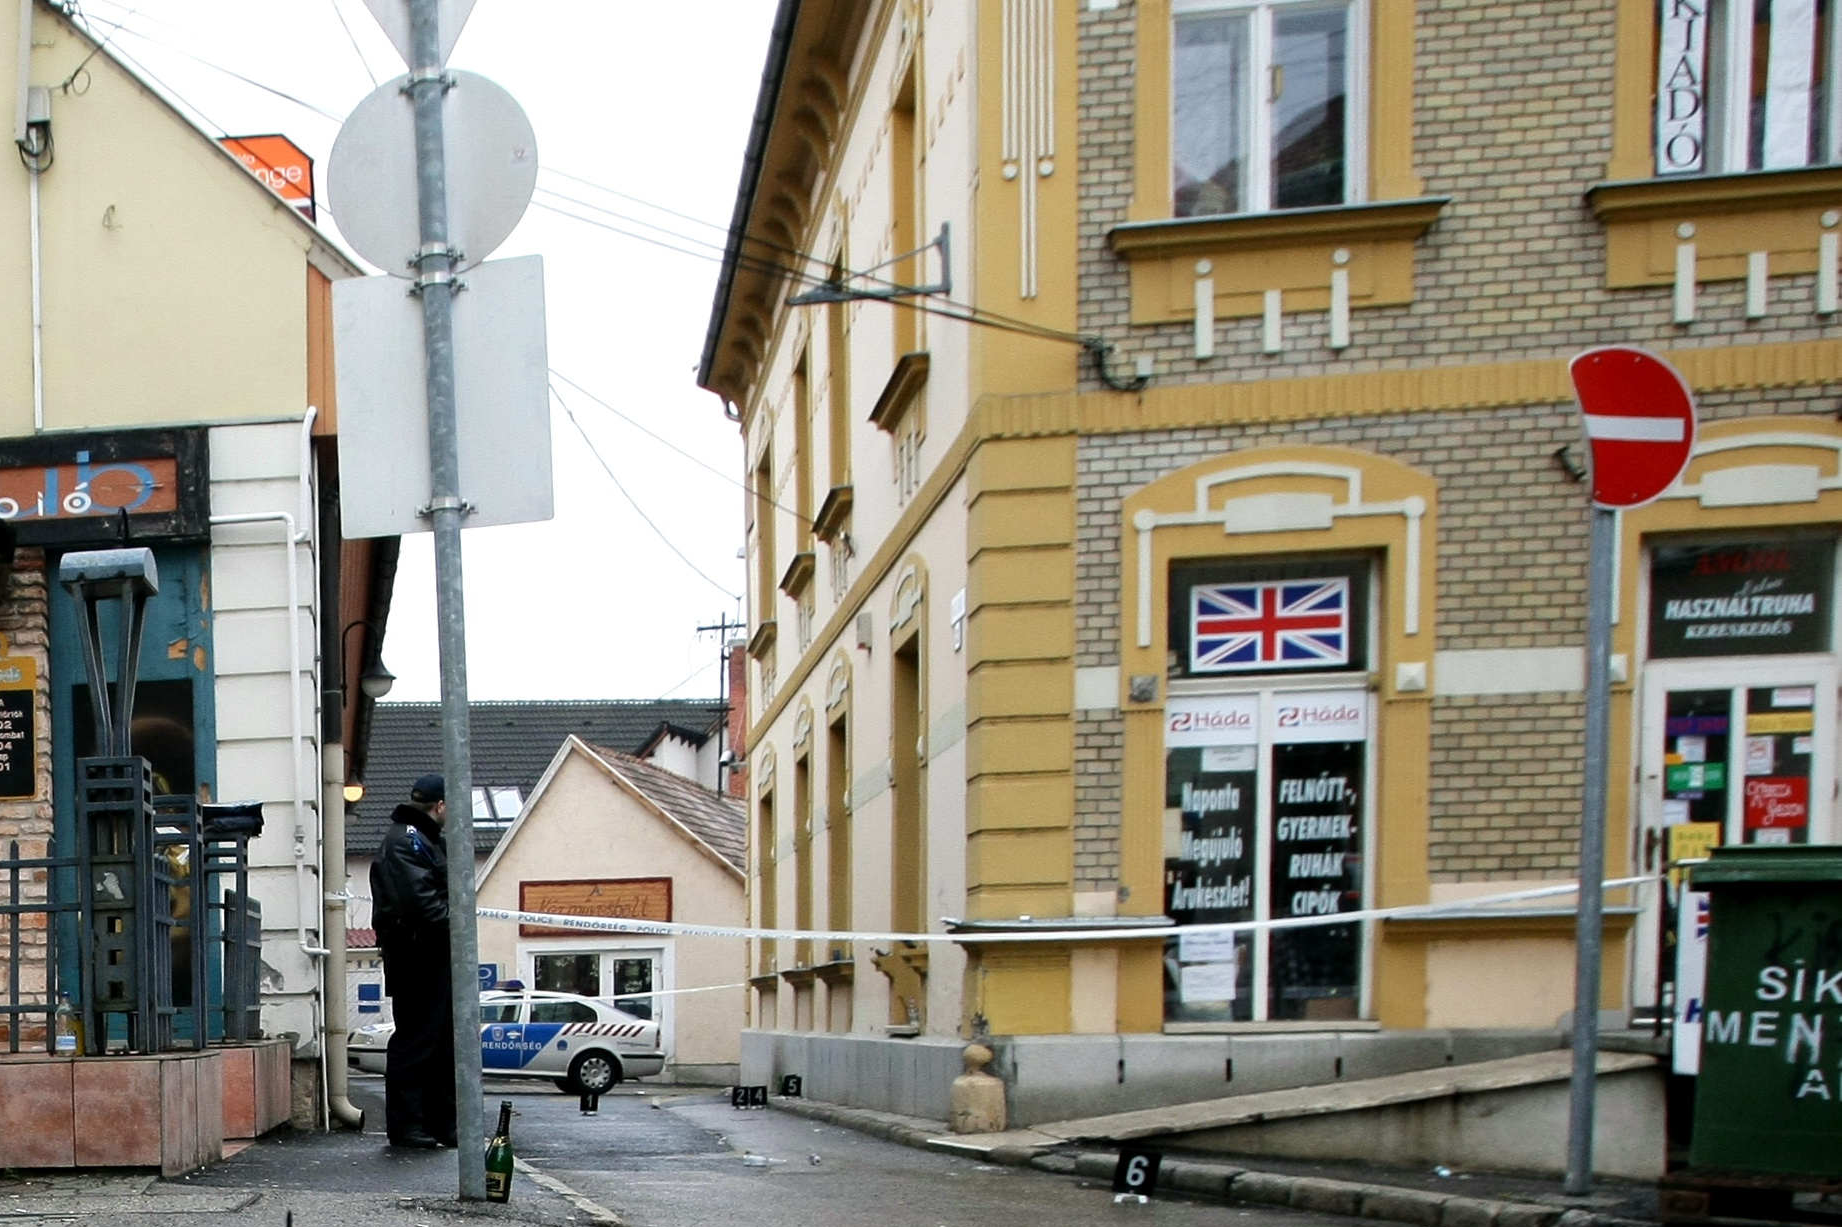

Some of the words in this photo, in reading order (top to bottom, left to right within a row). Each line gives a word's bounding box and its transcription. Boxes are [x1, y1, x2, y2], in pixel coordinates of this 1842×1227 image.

[1195, 710, 1251, 727] Háda
[1304, 705, 1359, 722] Háda
[1181, 782, 1240, 818] Naponta
[1277, 815, 1357, 841] GYERMEK-
[1181, 826, 1243, 868] Megújuló
[1288, 846, 1346, 879] RUHÁK
[1171, 871, 1251, 910] Árukészlet!
[1291, 884, 1342, 915] CIPŐK
[518, 914, 554, 924] POLICE
[482, 1041, 542, 1051] RENDŐRSÉG
[1706, 1011, 1842, 1063] MEN
[737, 1088, 745, 1103] 2
[755, 1088, 763, 1103] 4
[788, 1078, 797, 1093] 5
[1124, 1155, 1150, 1187] 6
